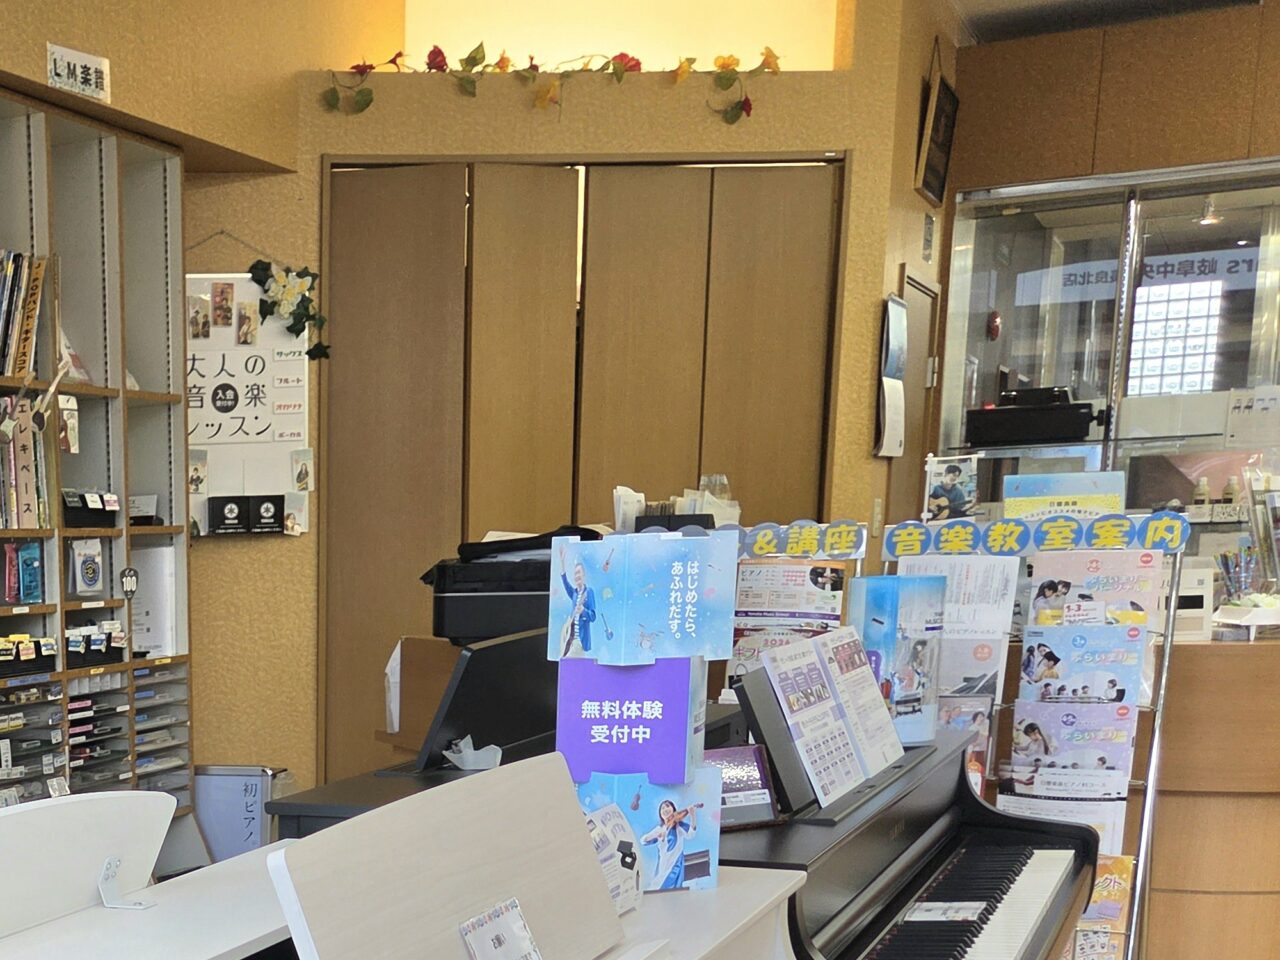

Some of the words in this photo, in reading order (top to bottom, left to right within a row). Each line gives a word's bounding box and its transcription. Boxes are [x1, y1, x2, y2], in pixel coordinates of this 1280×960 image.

[187, 353, 266, 379] 大人の
[18, 404, 33, 514] エレキベース
[892, 516, 1182, 557] 音楽教室案内
[122, 576, 136, 592] 100
[669, 560, 684, 640] あふれだす。
[685, 560, 700, 638] はじめたら、
[581, 700, 664, 720] 無料体験
[590, 725, 651, 743] 受付中
[241, 782, 258, 842] 初ピアノ
